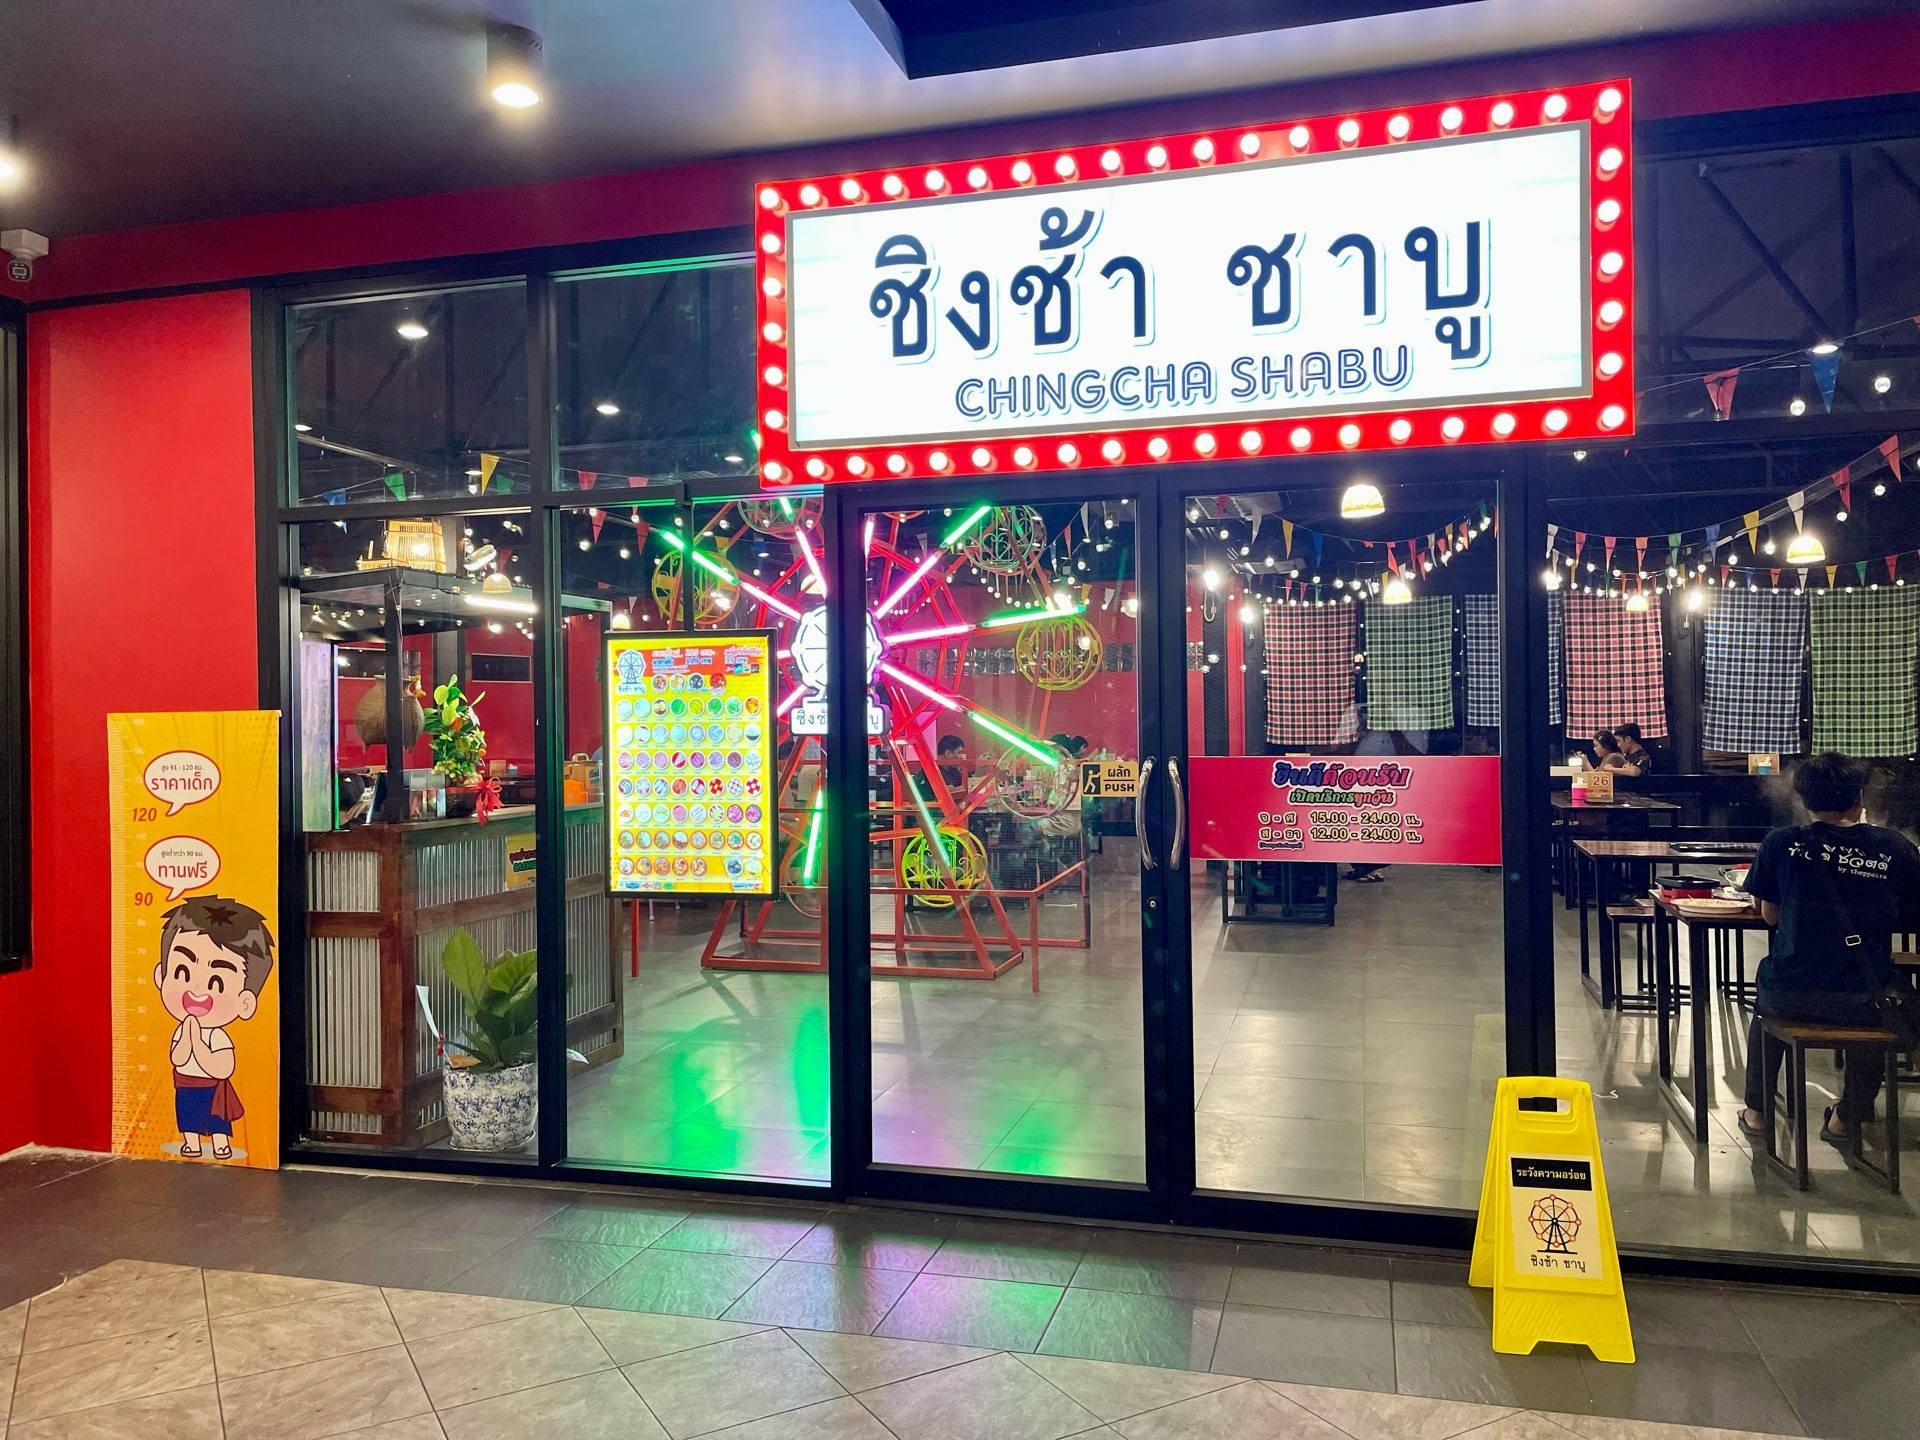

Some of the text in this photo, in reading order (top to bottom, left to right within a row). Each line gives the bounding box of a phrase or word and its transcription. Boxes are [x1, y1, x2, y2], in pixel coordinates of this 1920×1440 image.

[869, 207, 1481, 361] ชิงช้า ชาบู
[955, 344, 1408, 417] CHINGCHA SHABU
[1107, 765, 1131, 778] ผลัก
[1274, 761, 1410, 790] ยินดีต้อนรับ
[151, 771, 213, 790] ราคาเด็ก
[1104, 783, 1135, 792] PUSH
[1593, 775, 1609, 786] 26
[1289, 788, 1394, 807] เปิดบริการทุกวัน
[132, 807, 157, 822] 120
[1310, 811, 1348, 824] 15.00
[1361, 812, 1400, 824] 24.00
[1310, 827, 1348, 840] 12.00
[1361, 828, 1401, 840] 24.00
[158, 860, 208, 879] ทานฟรี
[1838, 866, 1847, 874] by
[134, 891, 153, 906] 90
[1516, 1166, 1587, 1181] ระวังความอร่อย
[1530, 1254, 1586, 1273] ชิงช้า ชาบู
